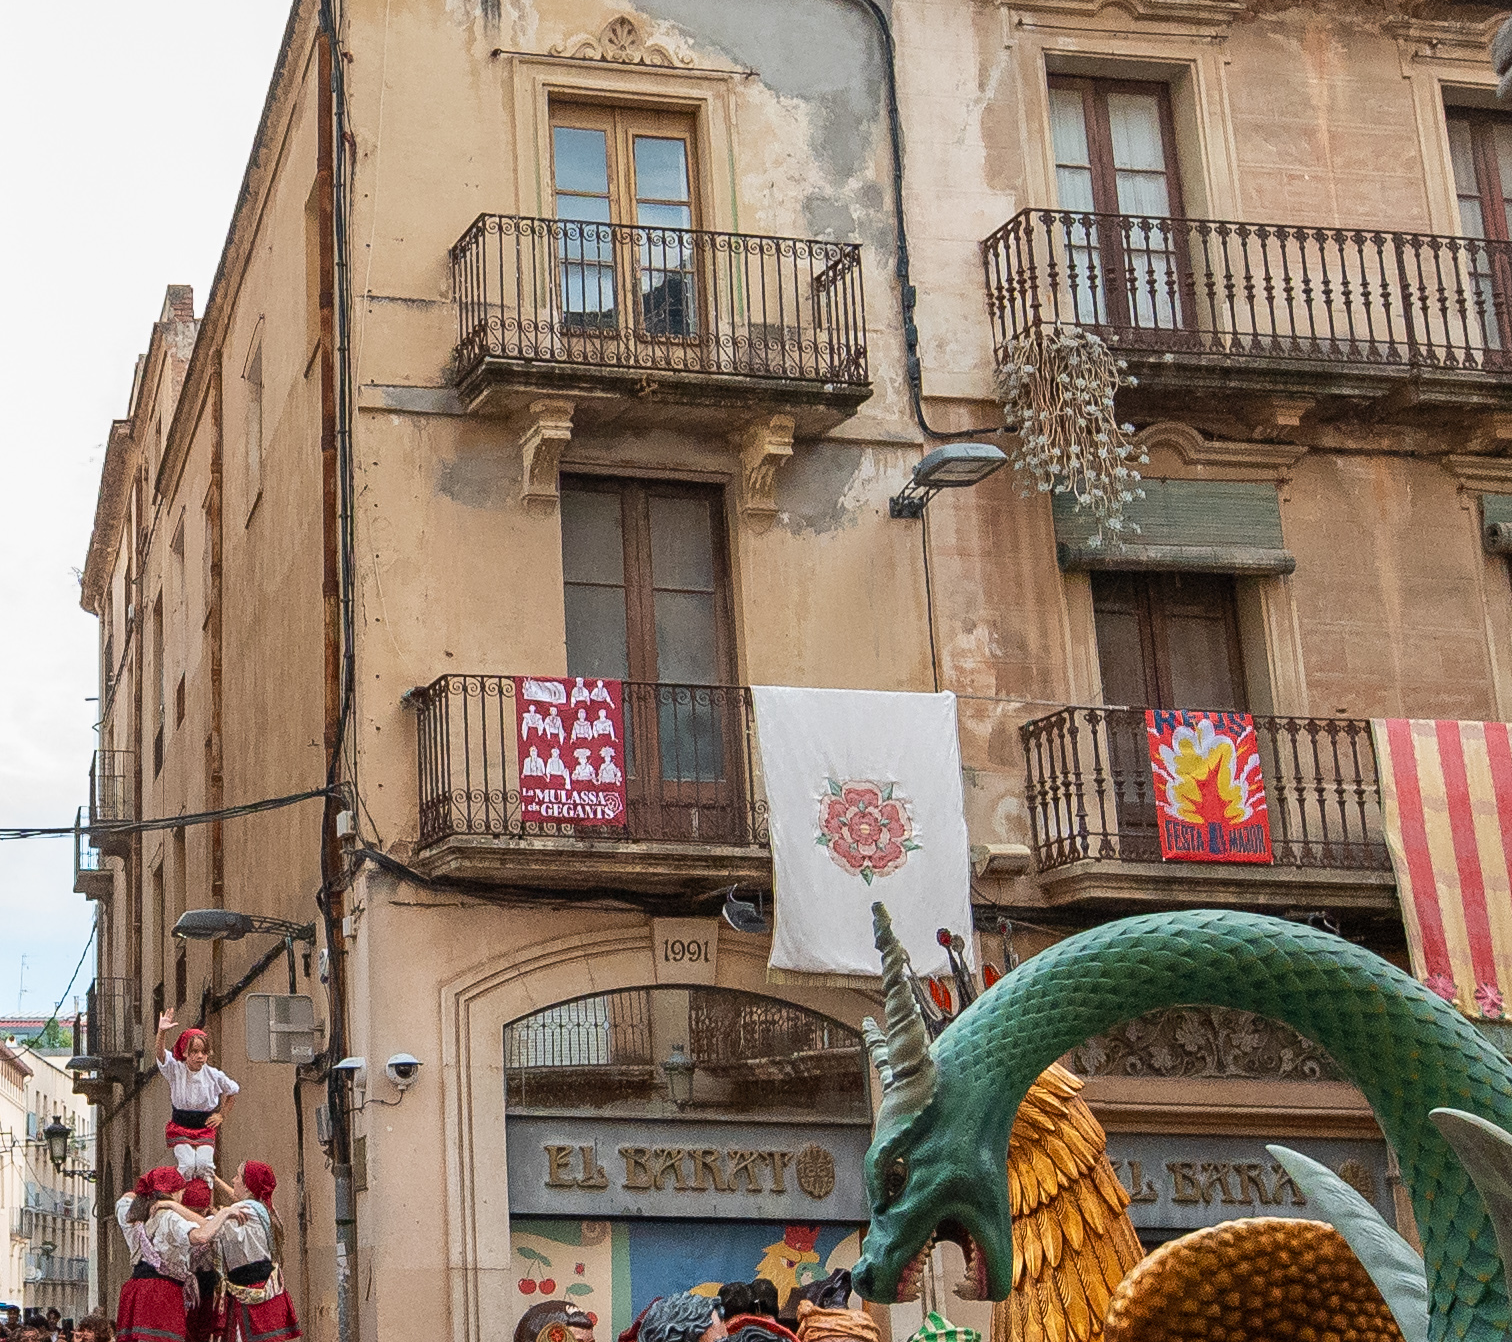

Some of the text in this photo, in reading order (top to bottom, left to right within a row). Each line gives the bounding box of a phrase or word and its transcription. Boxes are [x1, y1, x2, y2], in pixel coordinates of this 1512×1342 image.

[522, 787, 606, 805] La MULASSA
[527, 802, 540, 811] els
[540, 803, 615, 819] GEGANTS
[1165, 820, 1266, 853] FESTA MAJOR
[663, 938, 711, 963] 1991
[543, 1144, 609, 1190] EL
